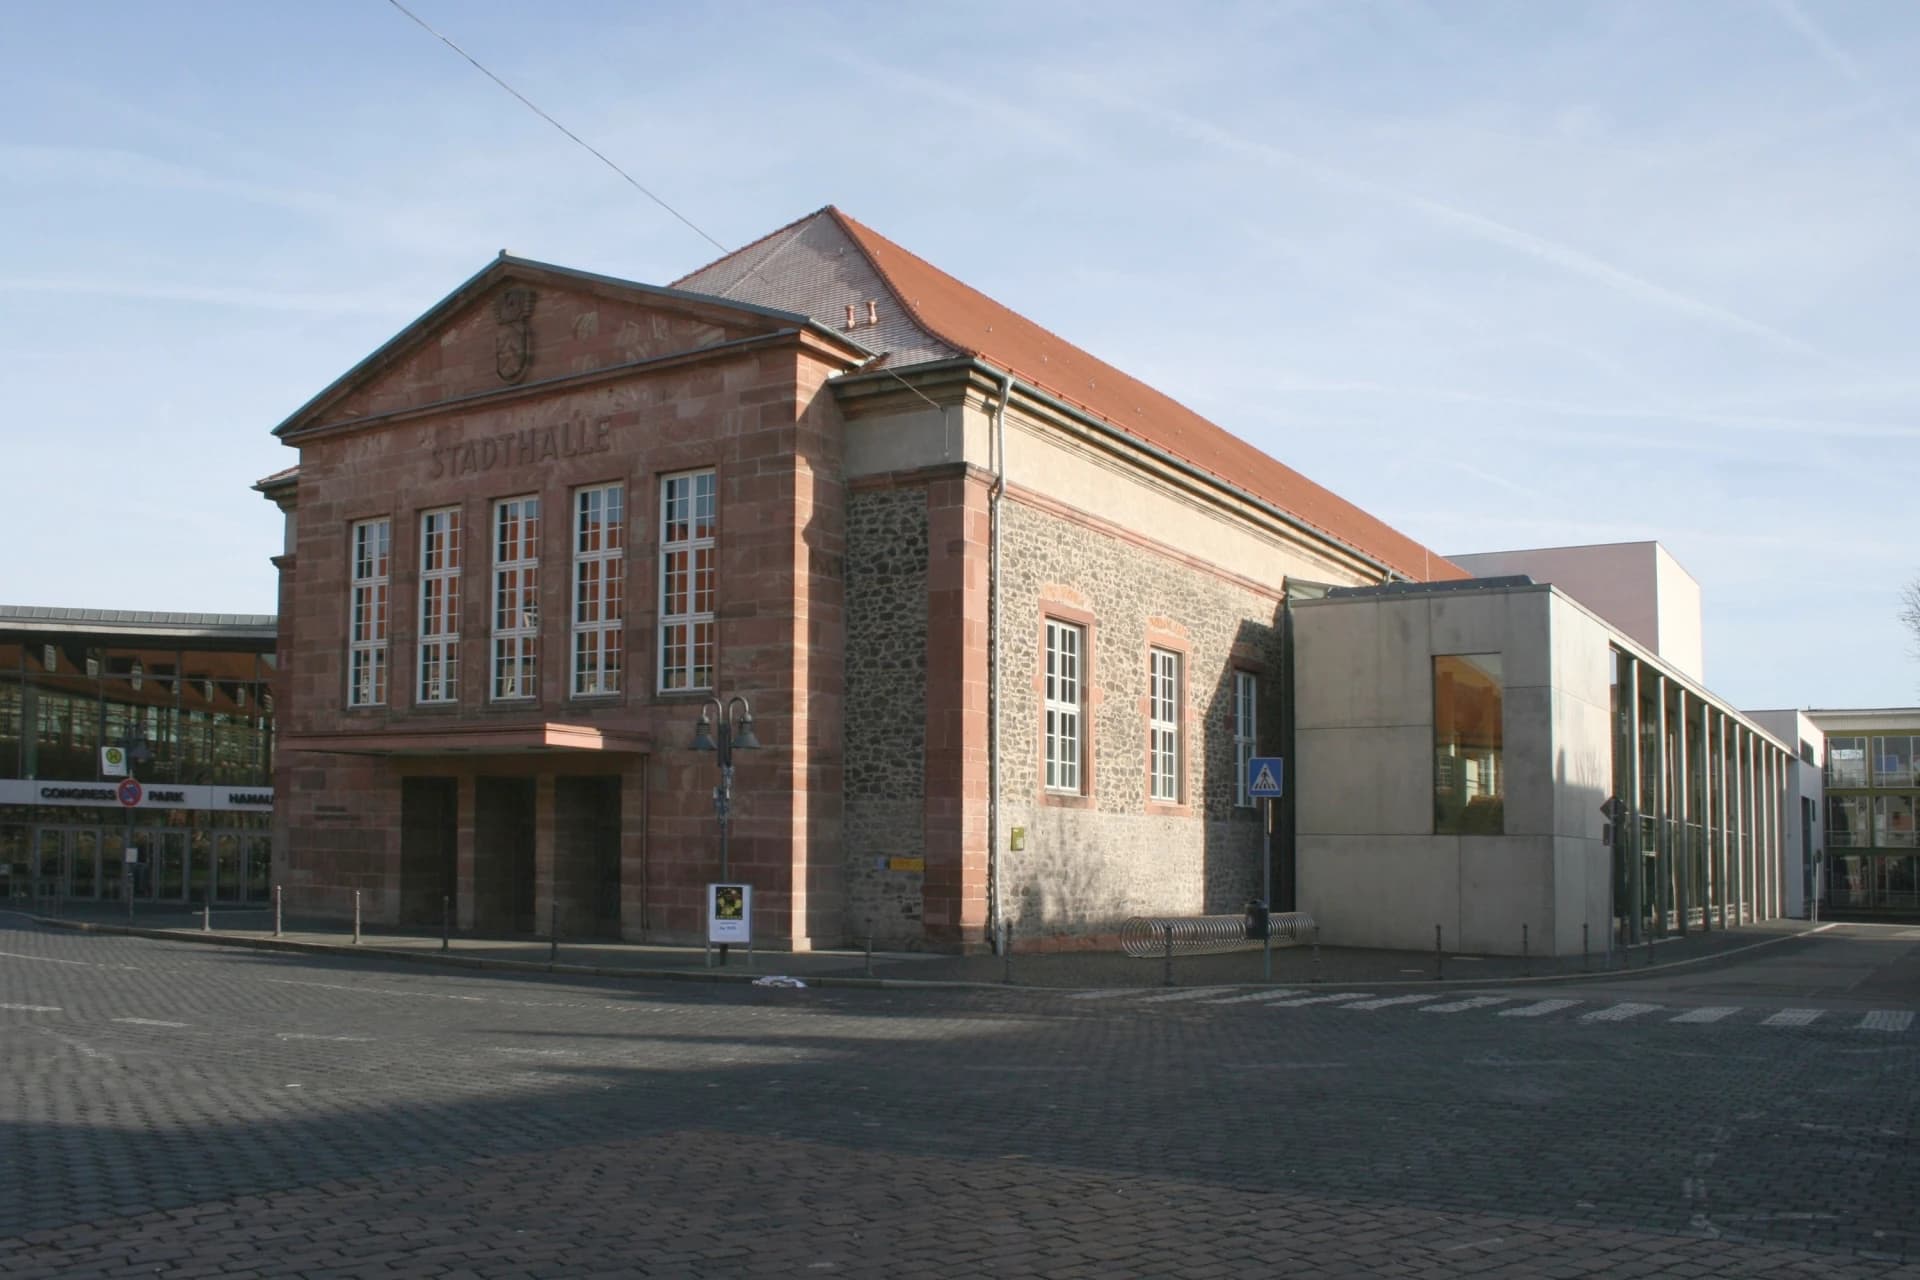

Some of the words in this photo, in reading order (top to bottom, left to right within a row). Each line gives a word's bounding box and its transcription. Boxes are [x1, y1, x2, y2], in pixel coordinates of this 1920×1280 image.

[431, 417, 610, 478] STADTHALLE
[41, 787, 116, 801] CONGRESS
[148, 790, 184, 802] PARK
